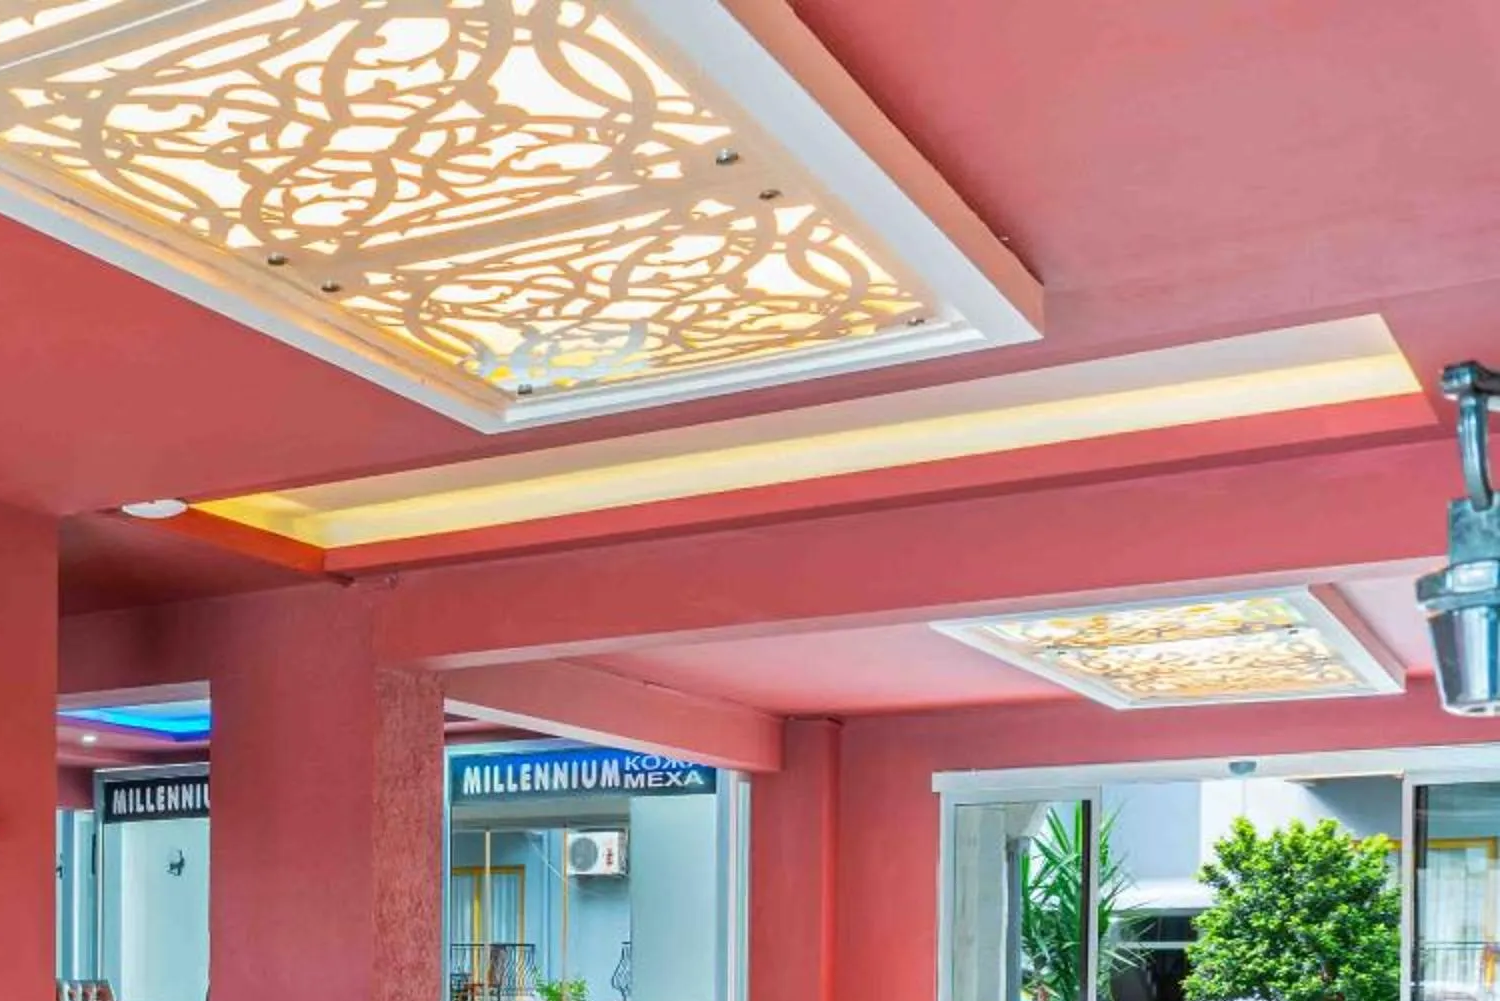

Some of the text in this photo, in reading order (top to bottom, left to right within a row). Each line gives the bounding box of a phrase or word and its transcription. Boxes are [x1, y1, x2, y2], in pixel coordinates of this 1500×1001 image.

[625, 755, 693, 771] КОЖ
[463, 758, 620, 795] MILLENNIUM
[624, 769, 704, 789] МЕХА
[112, 783, 210, 815] MILLENNIU
